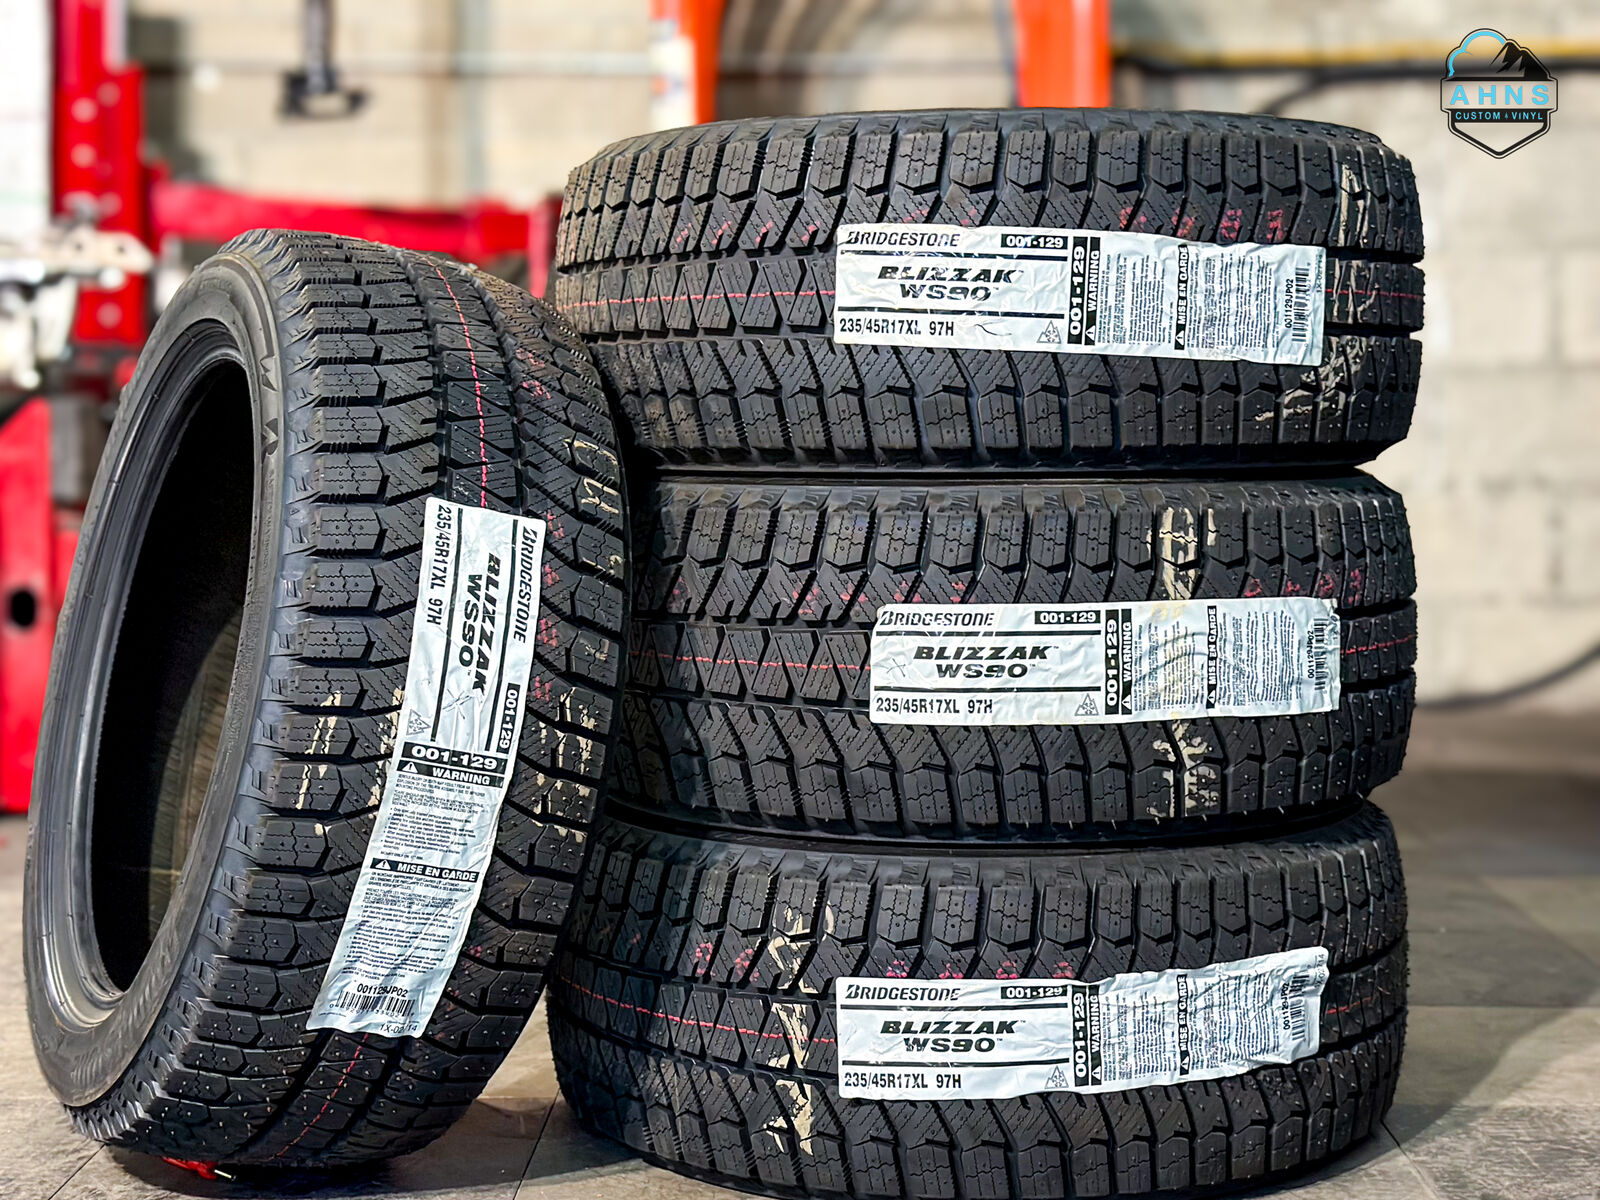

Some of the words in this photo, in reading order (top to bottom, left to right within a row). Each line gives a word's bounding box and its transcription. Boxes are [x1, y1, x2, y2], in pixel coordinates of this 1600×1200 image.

[846, 231, 960, 247] BRIDGESTONE
[1006, 235, 1064, 248] 001-129
[1179, 246, 1189, 282] GARDE
[1070, 246, 1085, 336] 001-129
[1088, 250, 1100, 312] WARNING
[1178, 283, 1187, 299] EN
[1178, 300, 1187, 325] MISE
[1285, 278, 1294, 328] 001129JP02
[840, 318, 921, 336] 235/45R17XL
[929, 321, 954, 336] 97H
[430, 504, 452, 590] 235/45R17XL
[513, 526, 538, 644] BRIDGESTONE
[426, 598, 443, 626] 97H
[880, 611, 994, 626] BRIDGESTONE
[1040, 612, 1096, 624] 001-129
[1208, 607, 1217, 643] GARDE
[1106, 619, 1118, 706] 001-129
[1123, 621, 1132, 681] WARNING
[1208, 644, 1217, 660] EN
[1208, 661, 1217, 685] MISE
[876, 698, 960, 714] 235/45R17XL
[968, 699, 992, 714] 97H
[499, 688, 518, 750] 001-129
[411, 746, 498, 769] 001-129
[432, 767, 491, 786] WARNING
[397, 861, 423, 875] MISE
[424, 866, 441, 877] EN
[441, 868, 477, 881] GARDE
[357, 983, 408, 998] 001129JP02
[845, 984, 960, 1001] BRIDGESTONE
[1006, 986, 1063, 999] 001-129
[1177, 975, 1188, 1009] GARDE
[1090, 994, 1101, 1052] WARNING
[1178, 1010, 1187, 1023] EN
[1073, 992, 1088, 1078] 001-129
[1180, 1024, 1189, 1051] MISE
[844, 1072, 928, 1089] 235/45R17XL
[936, 1073, 961, 1089] 97H
